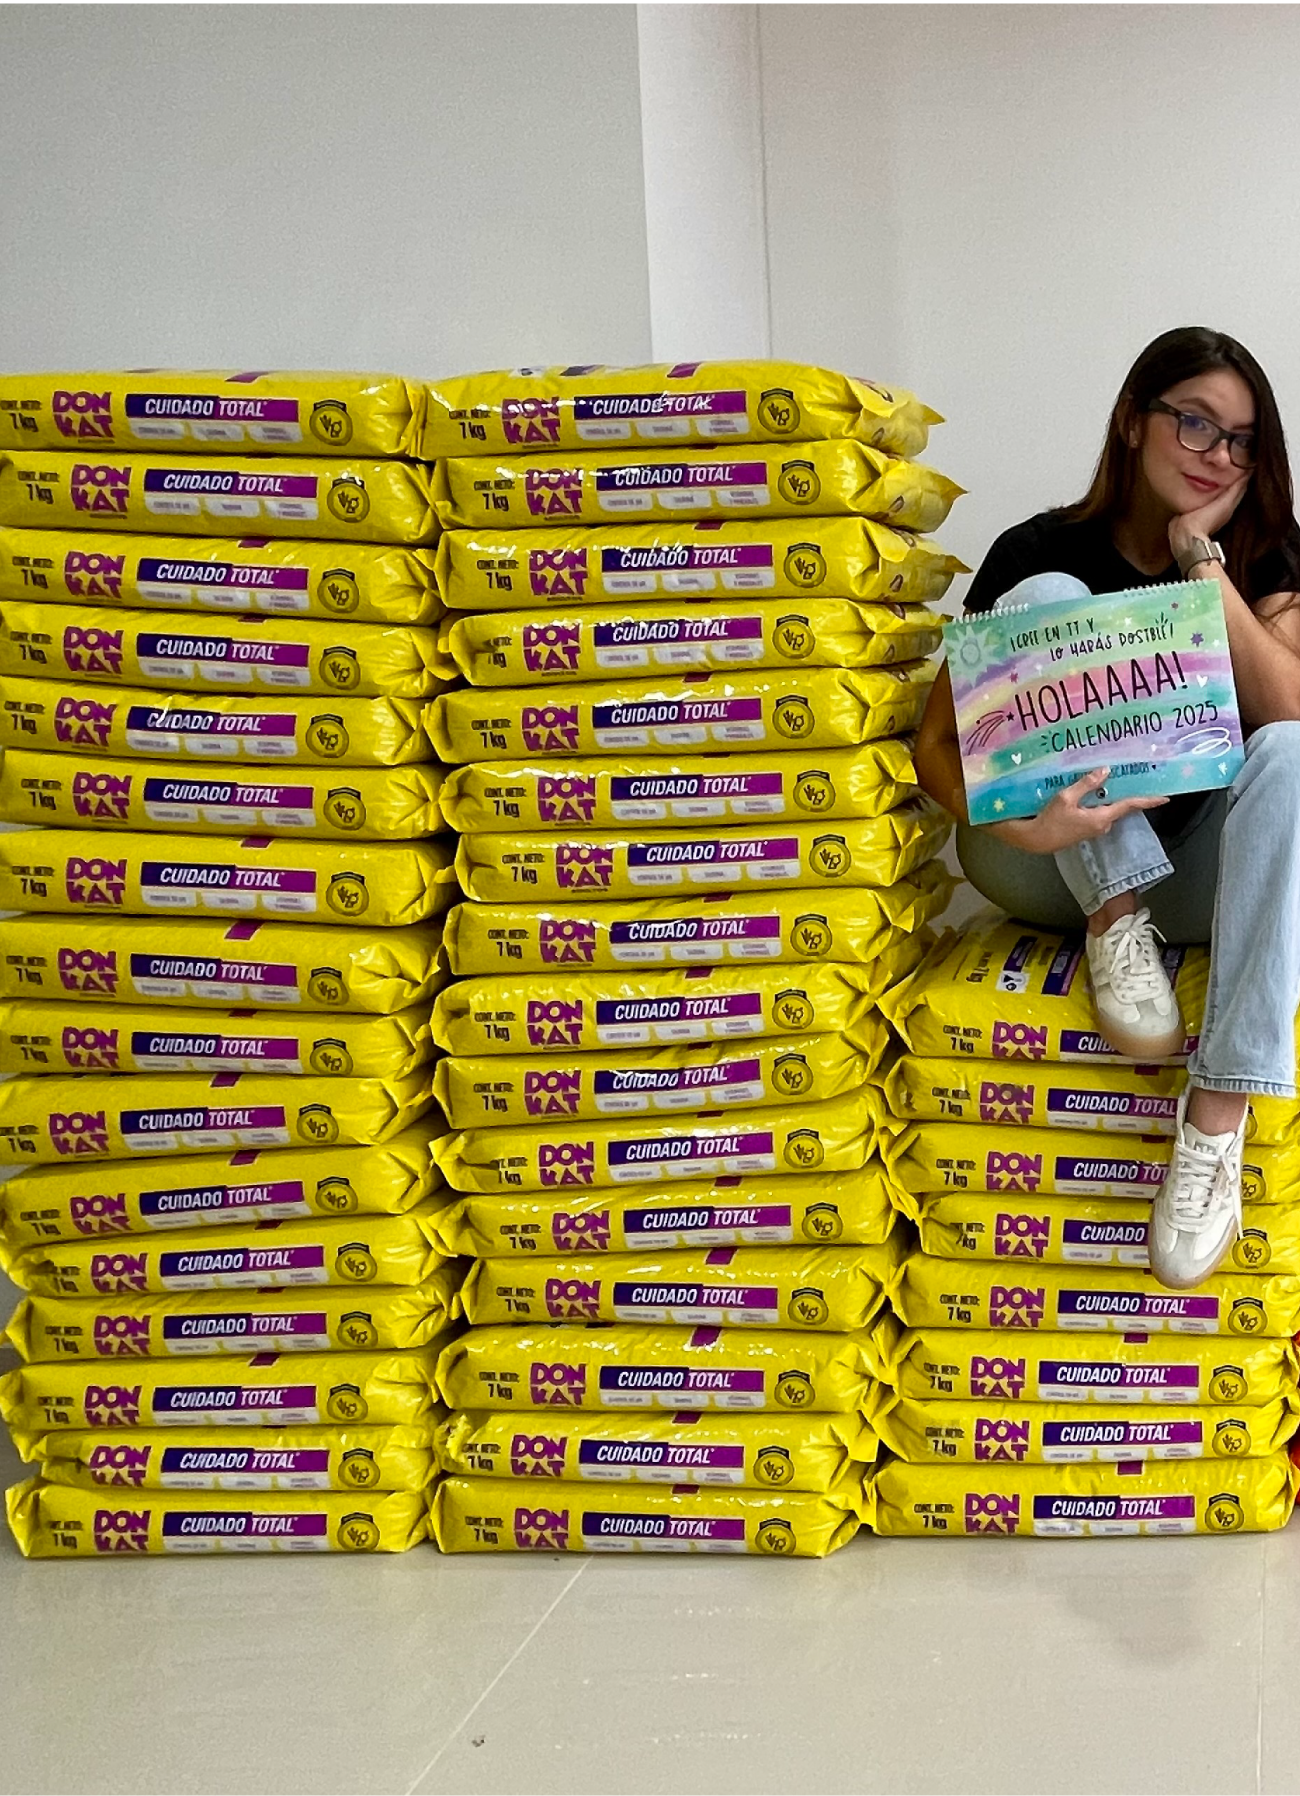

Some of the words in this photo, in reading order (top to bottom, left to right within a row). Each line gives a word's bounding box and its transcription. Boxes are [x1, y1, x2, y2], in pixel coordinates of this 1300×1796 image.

[53, 391, 112, 414] DON
[145, 399, 214, 416] CUIDADO
[220, 403, 264, 416] TOTAL
[11, 415, 18, 429] 7
[20, 414, 38, 433] kg
[54, 413, 113, 438] KAT
[72, 464, 132, 488] DON
[164, 475, 232, 491] CUIDADO
[238, 478, 283, 492] TOTAL
[27, 485, 34, 500] 7
[36, 485, 53, 504] kg
[71, 487, 130, 513] KAT
[1045, 625, 1060, 642] EN
[1087, 618, 1094, 633] Y
[1050, 647, 1063, 661] LO
[1014, 651, 1188, 731] HOLAAAA!
[522, 706, 579, 728] DON
[611, 705, 679, 722] CUIDADO
[683, 703, 728, 719] TOTAL
[1051, 712, 1163, 753] CALENDARIO
[1173, 700, 1219, 729] 2025
[481, 733, 488, 747] 7
[490, 733, 506, 749] kg
[523, 728, 579, 751] KAT
[73, 772, 133, 796] DON
[538, 777, 595, 799] DON
[630, 778, 698, 796] CUIDADO
[703, 778, 748, 793] TOTAL
[1044, 774, 1066, 790] PARA
[30, 792, 38, 806] 7
[40, 792, 57, 810] kg
[162, 785, 231, 801] CUIDADO
[236, 789, 280, 802] TOTAL
[73, 796, 129, 819] KAT
[493, 801, 500, 815] 7
[503, 801, 519, 818] kg
[538, 799, 596, 822] KAT
[552, 1211, 609, 1232] DON
[643, 1211, 708, 1228] CUIDADO
[713, 1210, 757, 1225] TOTAL
[510, 1235, 516, 1248] 7
[520, 1235, 536, 1250] kg
[552, 1231, 611, 1250] KAT
[990, 1286, 1044, 1307] DON
[1076, 1296, 1140, 1312] CUIDADO
[1144, 1299, 1187, 1313] TOTAL
[948, 1307, 955, 1320] 7
[956, 1306, 971, 1323] kg
[990, 1307, 1044, 1327] KAT
[95, 1316, 150, 1336] DON
[181, 1318, 246, 1334] CUIDADO
[251, 1317, 294, 1332] TOTAL
[55, 1338, 61, 1351] 7
[64, 1338, 79, 1353] kg
[94, 1337, 150, 1355] KAT
[530, 1362, 586, 1386] DON
[618, 1371, 683, 1388] CUIDADO
[688, 1374, 731, 1388] TOTAL
[488, 1384, 494, 1397] 7
[497, 1384, 513, 1400] kg
[530, 1385, 586, 1405] KAT
[965, 1493, 1019, 1514] DON
[1051, 1500, 1116, 1516] CUIDADO
[1120, 1501, 1163, 1515] TOTAL
[923, 1516, 930, 1528] 7
[932, 1516, 947, 1531] kg
[965, 1514, 1019, 1534] KAT
